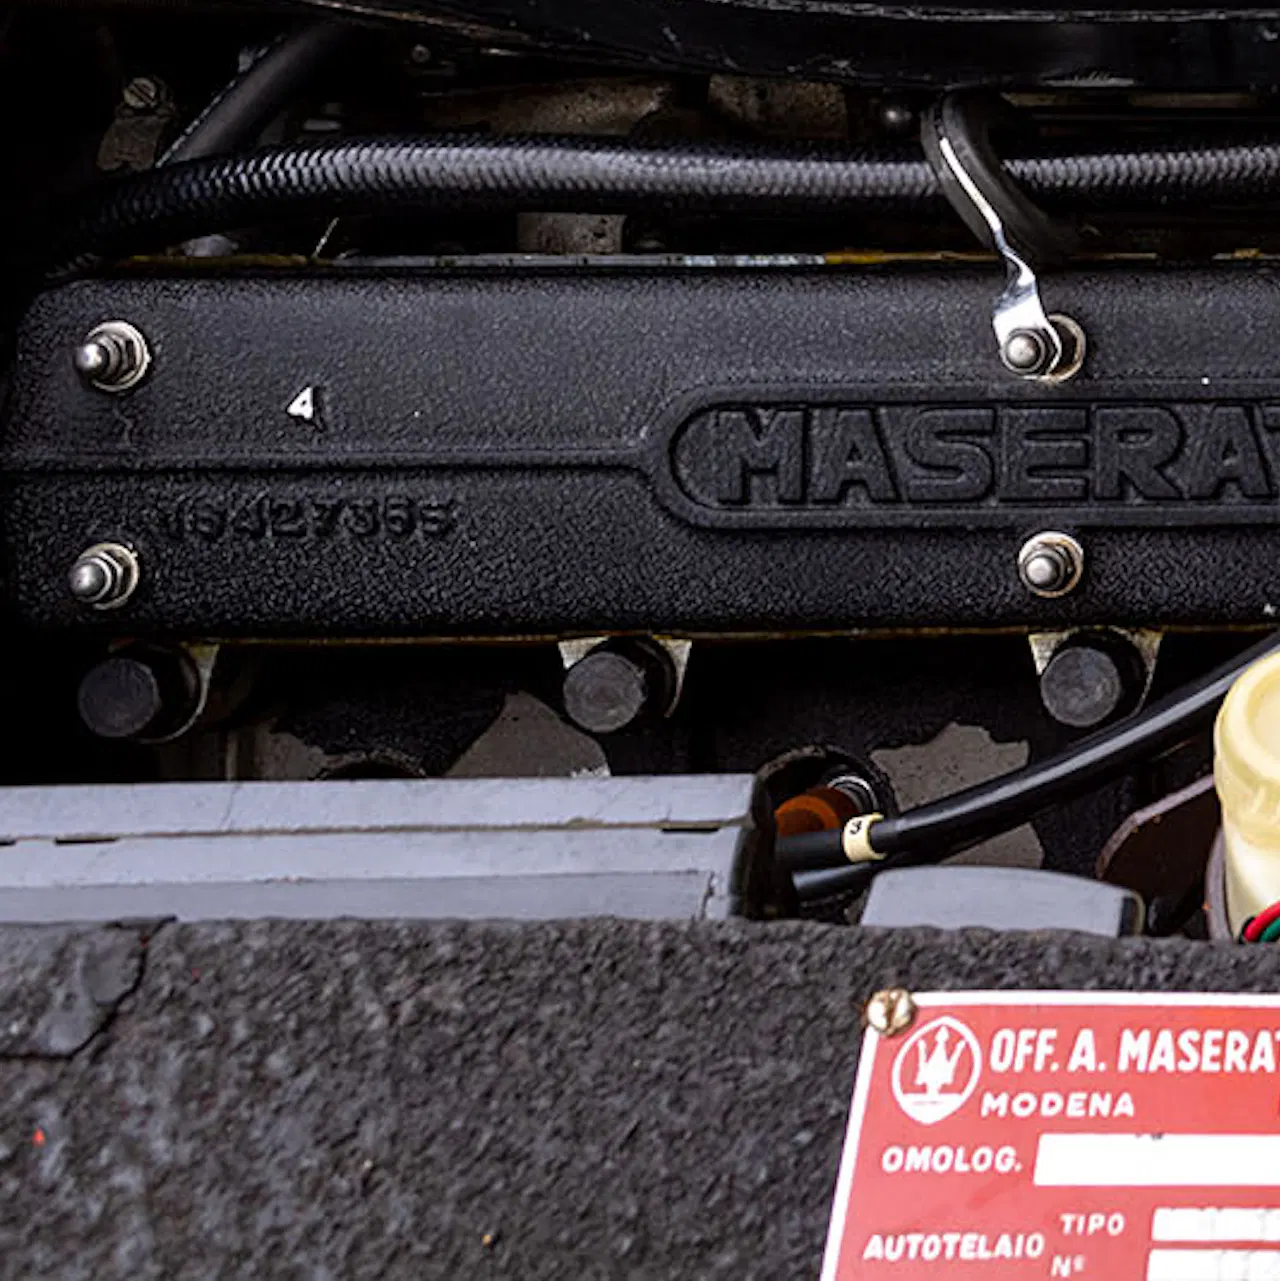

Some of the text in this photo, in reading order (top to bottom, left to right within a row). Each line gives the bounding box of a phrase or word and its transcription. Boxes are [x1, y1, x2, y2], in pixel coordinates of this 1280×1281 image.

[287, 386, 314, 420] 4
[990, 1028, 1060, 1073] OFF.
[1067, 1029, 1107, 1073] A.
[981, 1092, 1136, 1118] MODENA
[881, 1146, 1023, 1173] OMOLOG.
[1060, 1213, 1126, 1236] TIPO
[863, 1233, 1045, 1261] AUTOTELAIO
